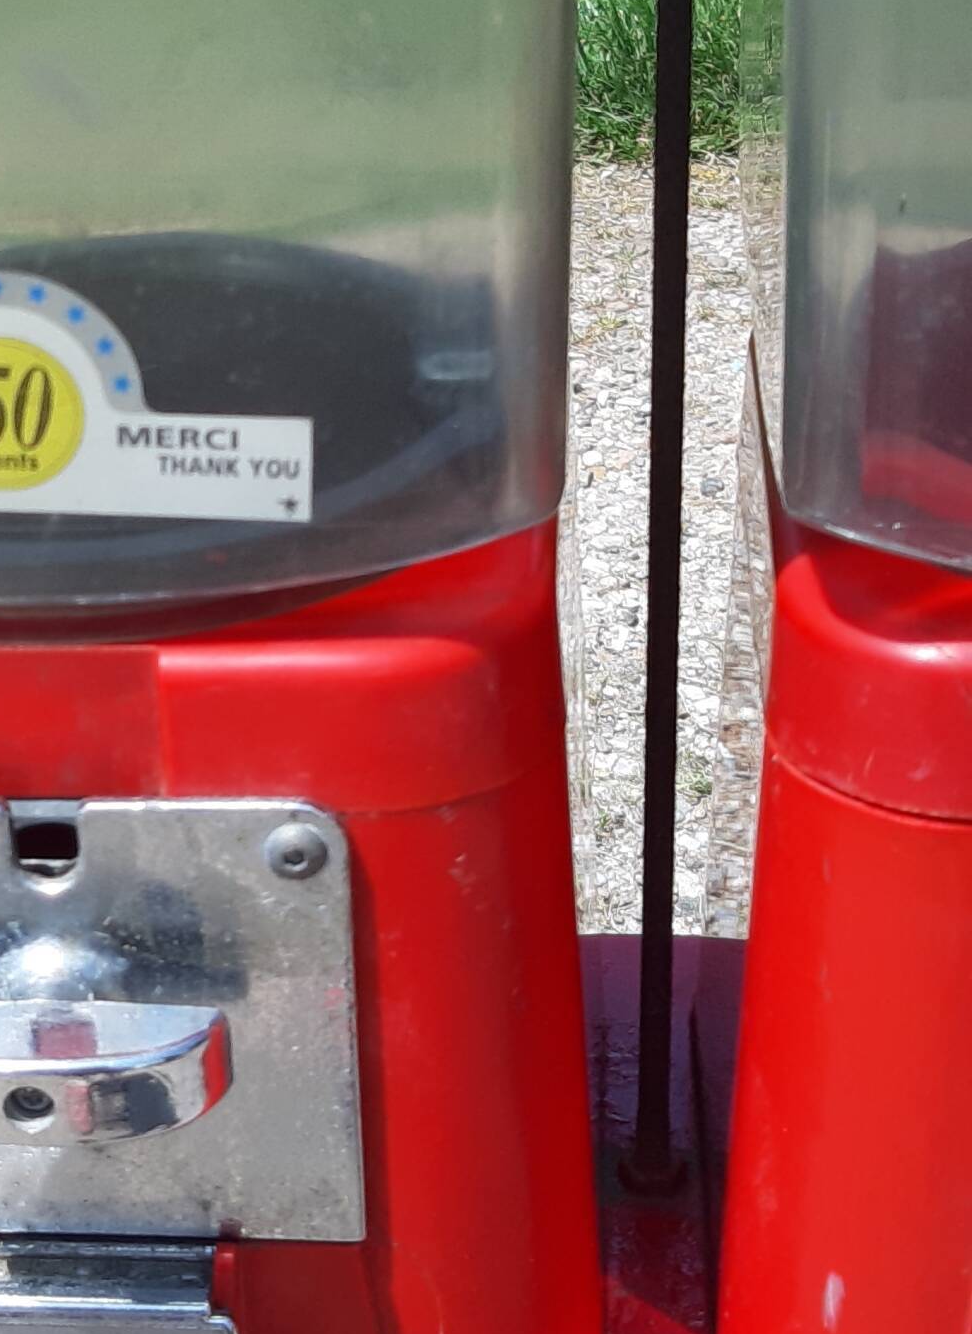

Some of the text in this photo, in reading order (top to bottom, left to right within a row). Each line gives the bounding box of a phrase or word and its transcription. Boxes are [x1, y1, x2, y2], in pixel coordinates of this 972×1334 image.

[117, 425, 239, 450] MERCI
[158, 455, 300, 480] THANK YOU
